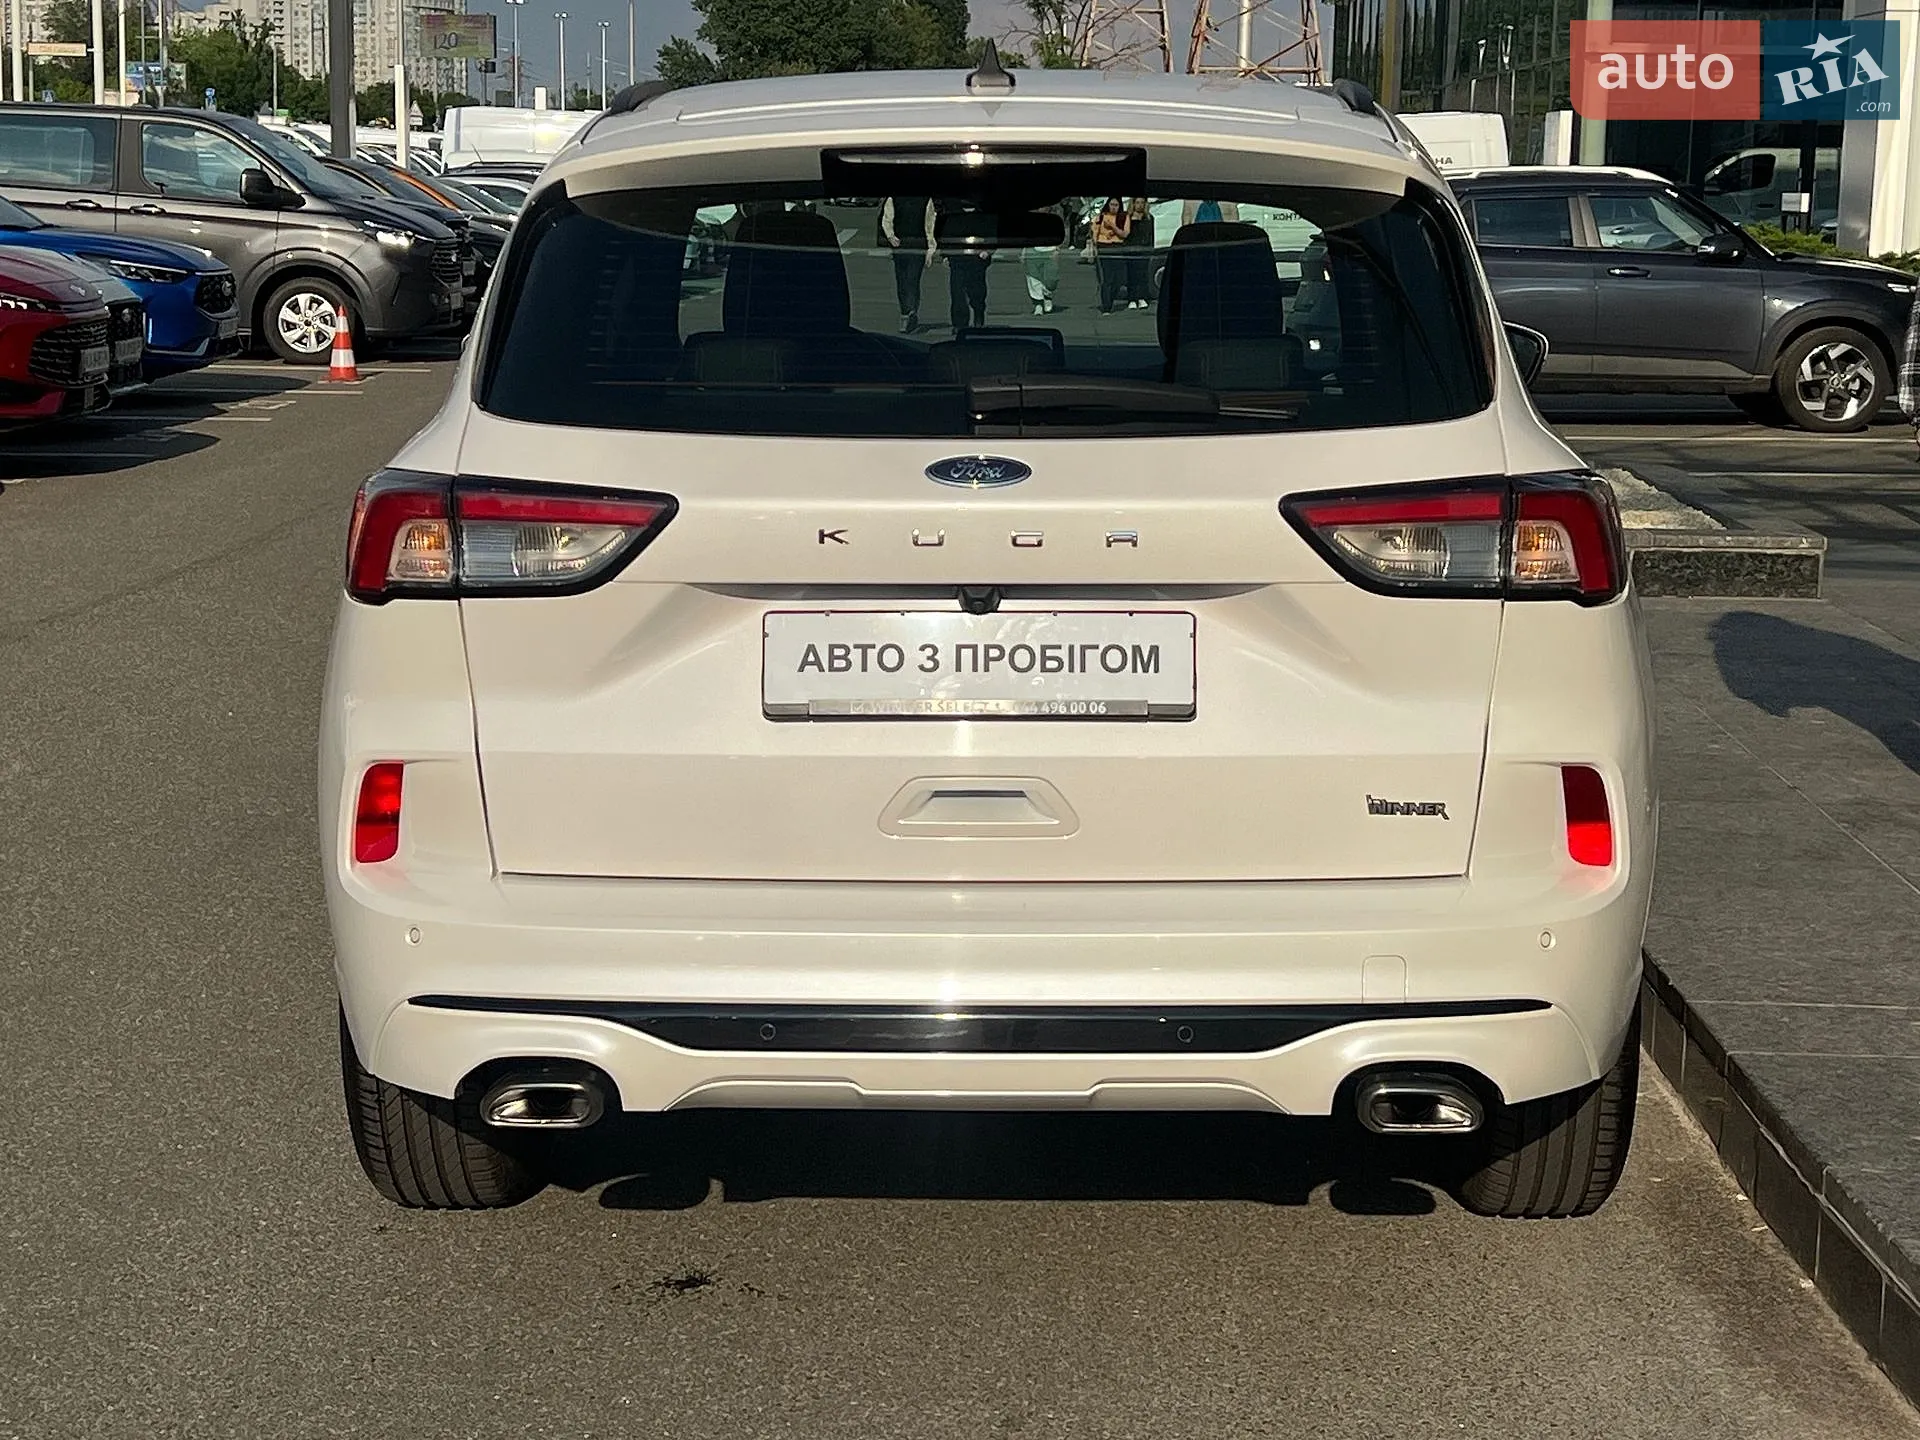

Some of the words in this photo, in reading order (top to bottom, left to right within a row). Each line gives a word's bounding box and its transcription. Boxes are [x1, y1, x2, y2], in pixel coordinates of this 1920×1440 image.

[949, 459, 1006, 480] Ford
[817, 528, 1139, 548] KUGA
[797, 643, 905, 674] АВТО
[954, 643, 1160, 674] ПРОБІГОМ
[1040, 701, 1067, 714] 496
[1070, 701, 1087, 714] 00
[1089, 701, 1108, 714] 06
[1366, 794, 1450, 820] WINNER
